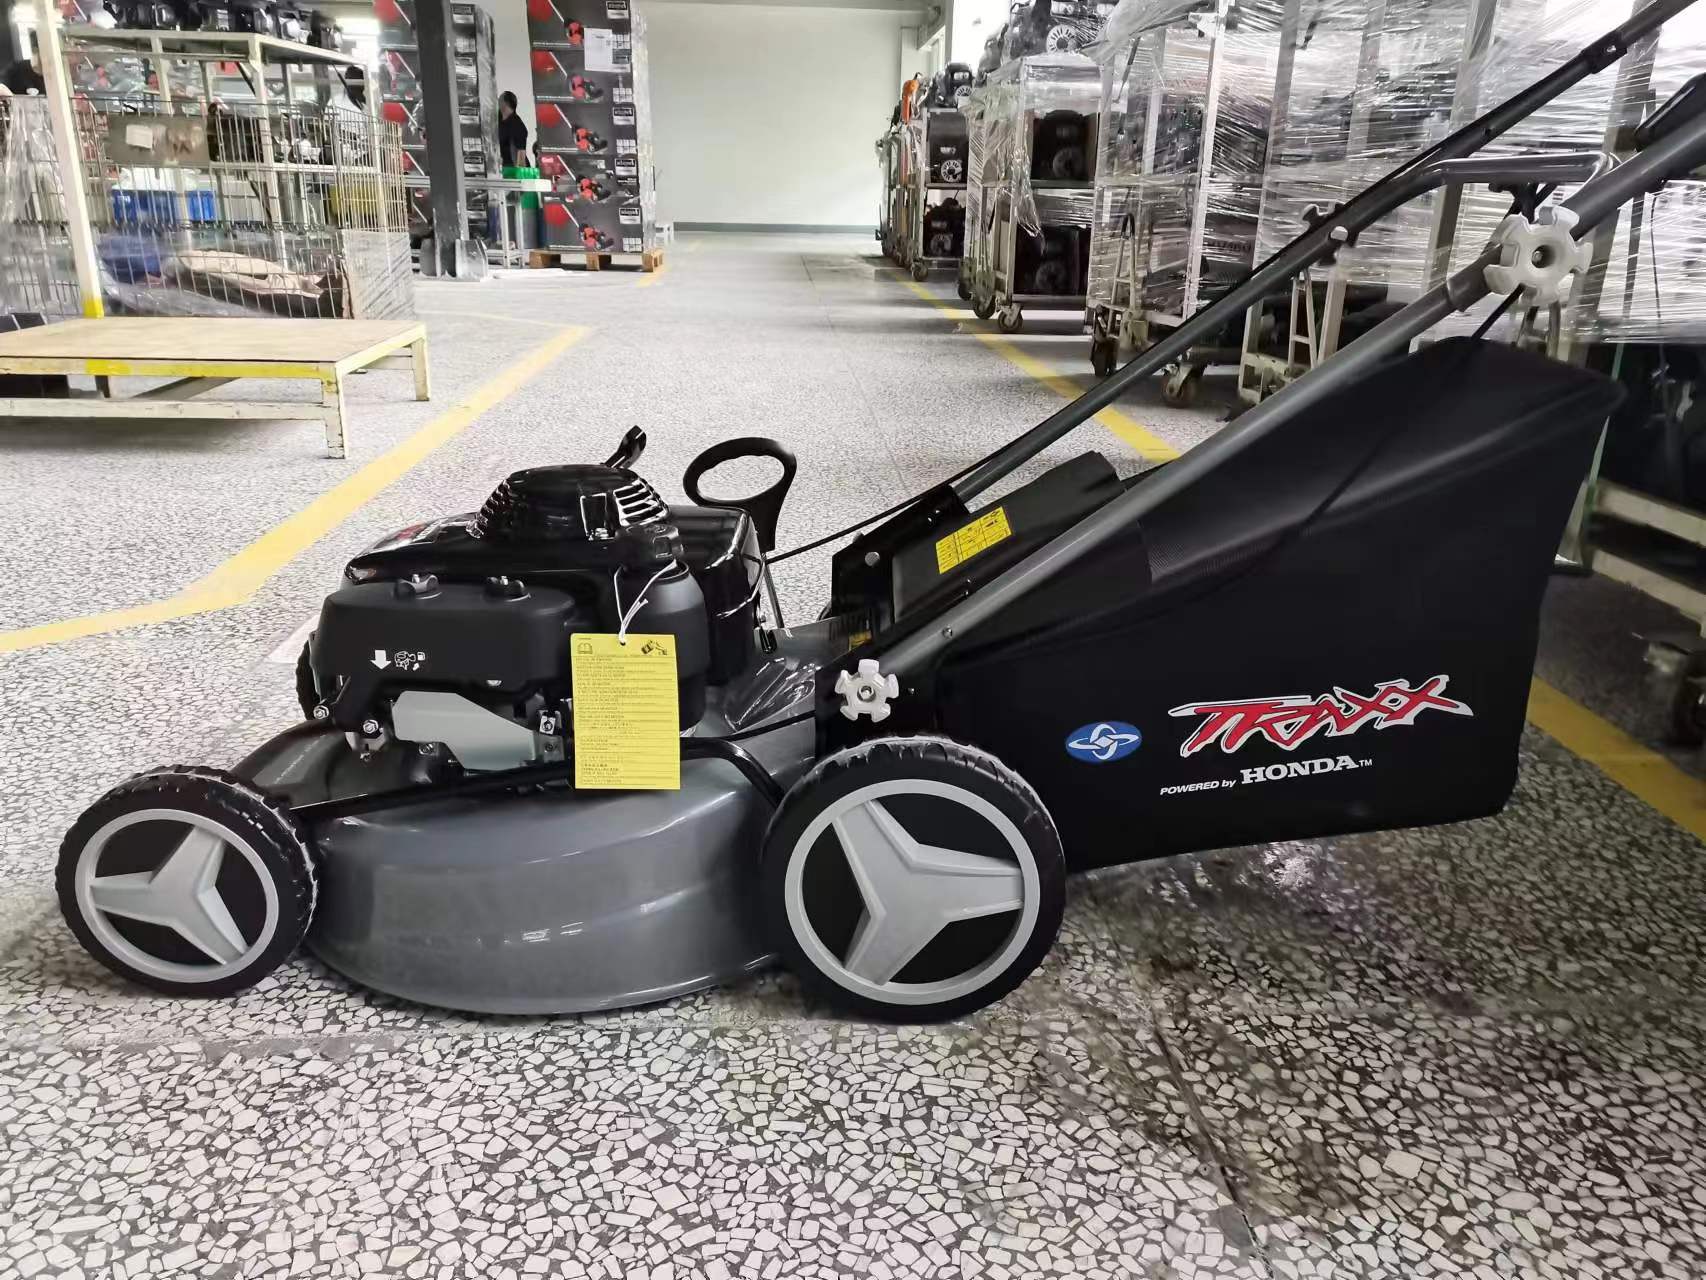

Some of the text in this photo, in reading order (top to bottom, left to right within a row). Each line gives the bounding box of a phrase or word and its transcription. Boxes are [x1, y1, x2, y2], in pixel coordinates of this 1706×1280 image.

[1160, 780, 1219, 795] POWERED
[1221, 779, 1237, 788] by
[1240, 755, 1359, 784] HONDA
